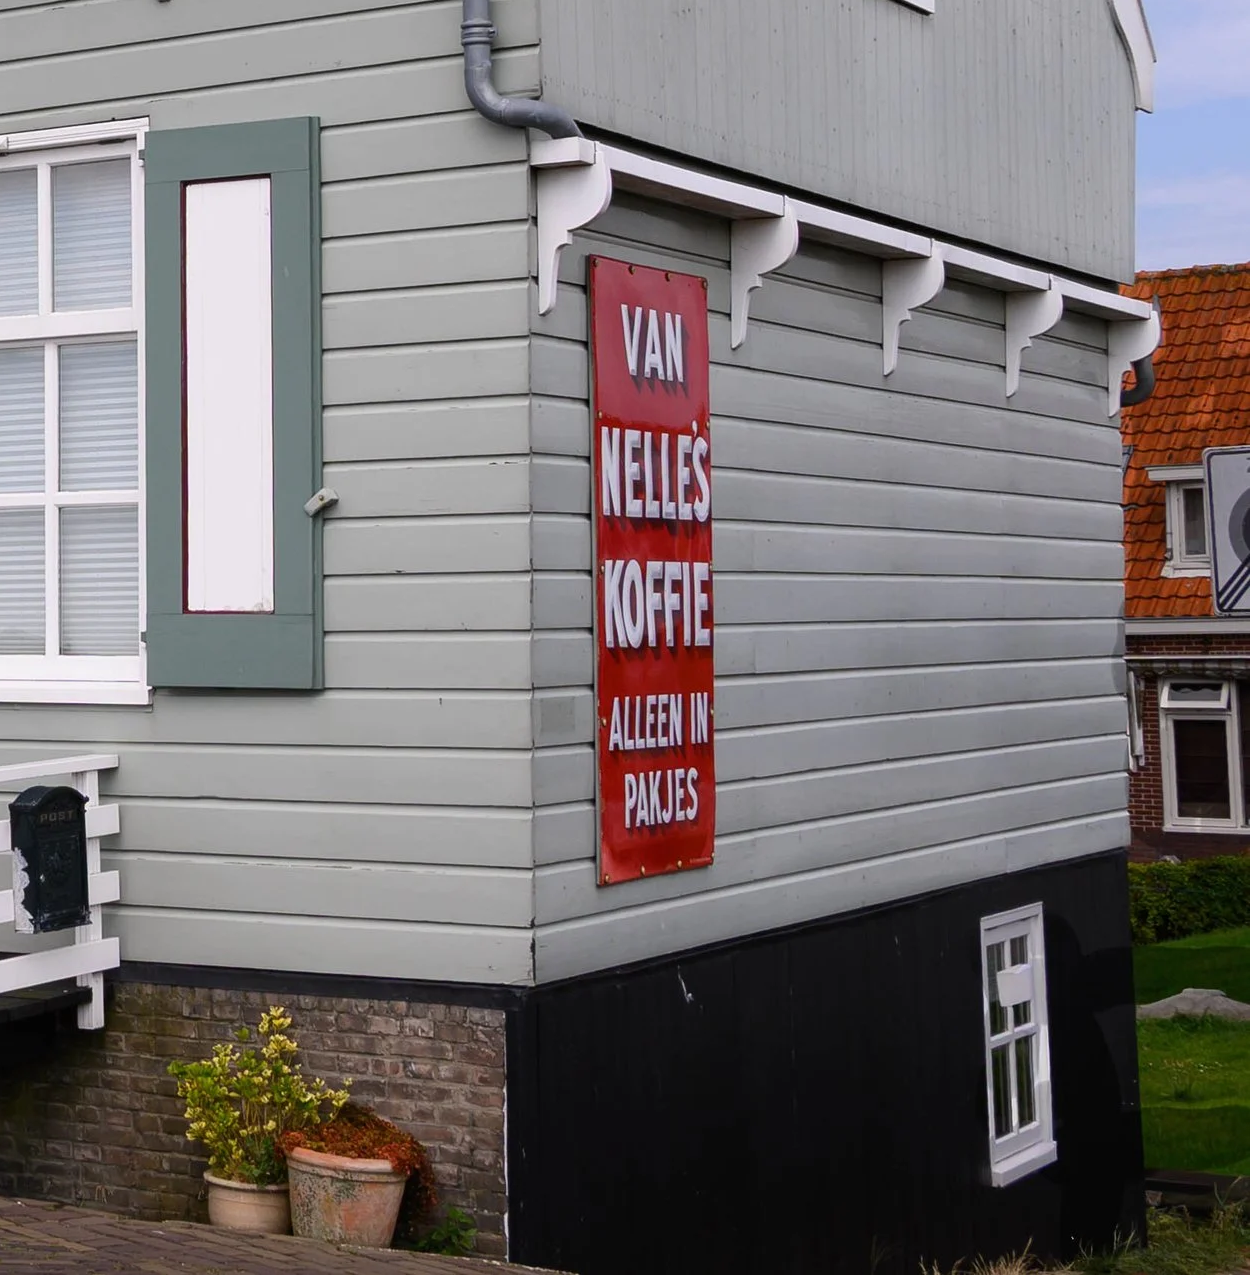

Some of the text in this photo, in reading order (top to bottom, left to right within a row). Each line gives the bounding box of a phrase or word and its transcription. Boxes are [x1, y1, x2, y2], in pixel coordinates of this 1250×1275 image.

[620, 303, 684, 383] VAN
[601, 420, 710, 522] NELLE'S
[604, 559, 711, 649] KOFFIE
[608, 692, 709, 751] ALLEEN IN
[40, 810, 74, 823] POST
[624, 767, 699, 829] PAKJES
